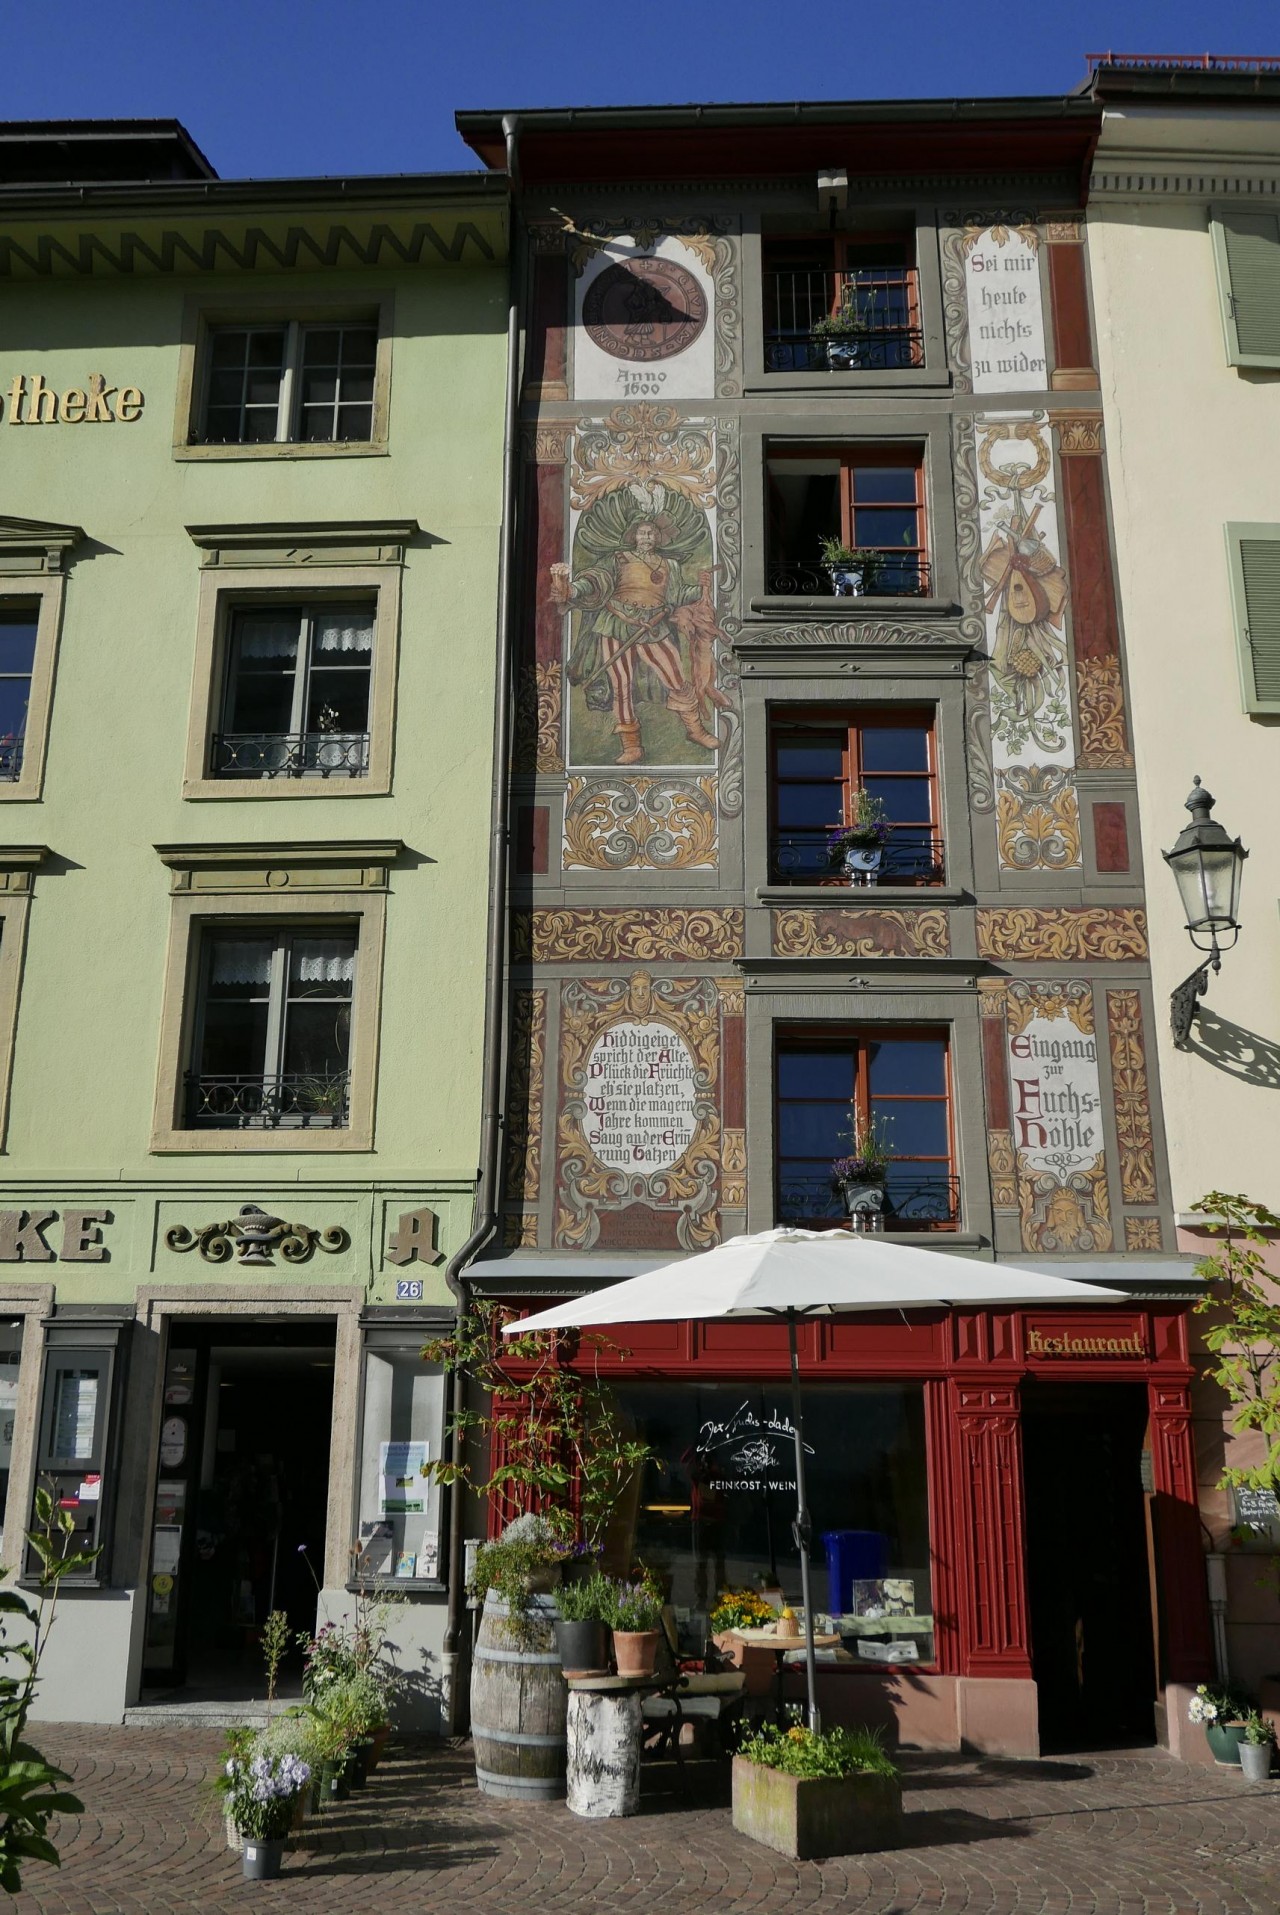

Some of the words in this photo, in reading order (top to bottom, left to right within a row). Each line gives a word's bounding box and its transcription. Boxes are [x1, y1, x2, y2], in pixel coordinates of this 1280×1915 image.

[971, 253, 998, 273] Sei
[1004, 254, 1035, 272] mir
[981, 286, 1027, 312] heute
[979, 318, 1033, 345] nichts
[974, 360, 992, 378] zu
[997, 352, 1046, 374] wider
[615, 368, 667, 384] Anno
[0, 371, 144, 425] theke
[624, 382, 660, 397] 1600
[593, 1049, 634, 1065] spricht
[636, 1048, 658, 1063] der
[1010, 1034, 1098, 1063] Eingang
[589, 1063, 631, 1079] Pflück
[632, 1063, 649, 1079] die
[648, 1063, 694, 1082] Früchte
[1042, 1065, 1064, 1080] zur
[616, 1080, 634, 1095] sie
[589, 1095, 627, 1112] Wenn
[629, 1097, 648, 1111] die
[648, 1099, 693, 1114] magern
[594, 1112, 631, 1131] Jahre
[634, 1112, 684, 1128] kommen
[589, 1130, 623, 1148] Saug
[1014, 1115, 1096, 1152] Höhle
[631, 1144, 677, 1165] Tatzen
[400, 1281, 419, 1297] 26
[1028, 1330, 1143, 1353] Restaurant
[709, 1481, 761, 1490] FEINKOST
[768, 1481, 797, 1490] WEIN
